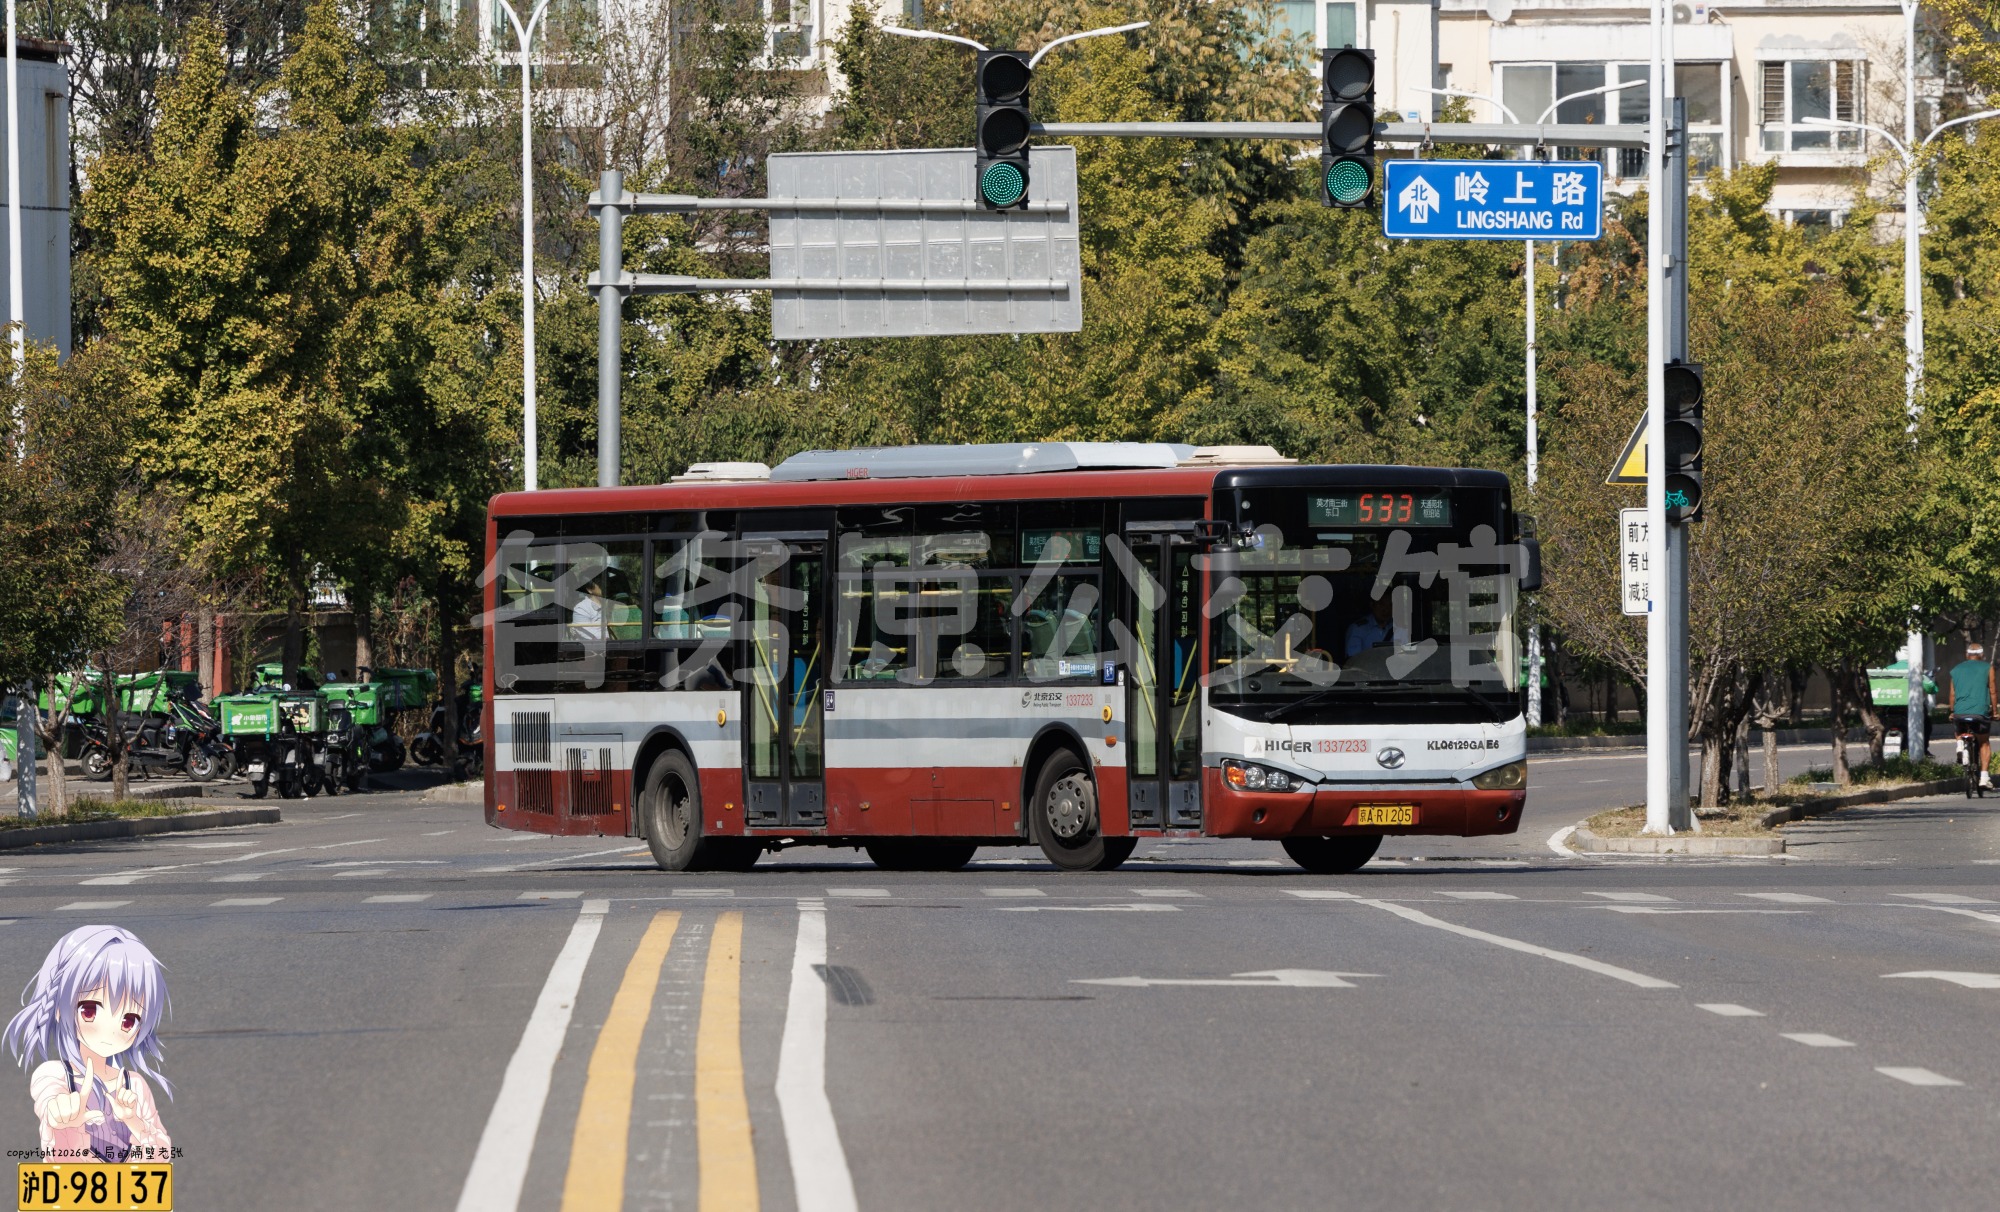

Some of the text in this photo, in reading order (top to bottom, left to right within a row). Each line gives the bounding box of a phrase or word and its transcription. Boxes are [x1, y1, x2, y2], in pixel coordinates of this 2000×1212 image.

[1410, 184, 1428, 202] 北
[1455, 171, 1587, 205] 岭上路
[1414, 204, 1425, 220] N
[1457, 210, 1584, 230] LINGSHANG Rd
[846, 467, 869, 477] HIGER
[1359, 493, 1413, 523] 533
[1033, 692, 1063, 701] 北京公交
[1065, 693, 1094, 707] 1337233
[1264, 740, 1312, 753] HIGER
[1317, 739, 1367, 753] 1337233
